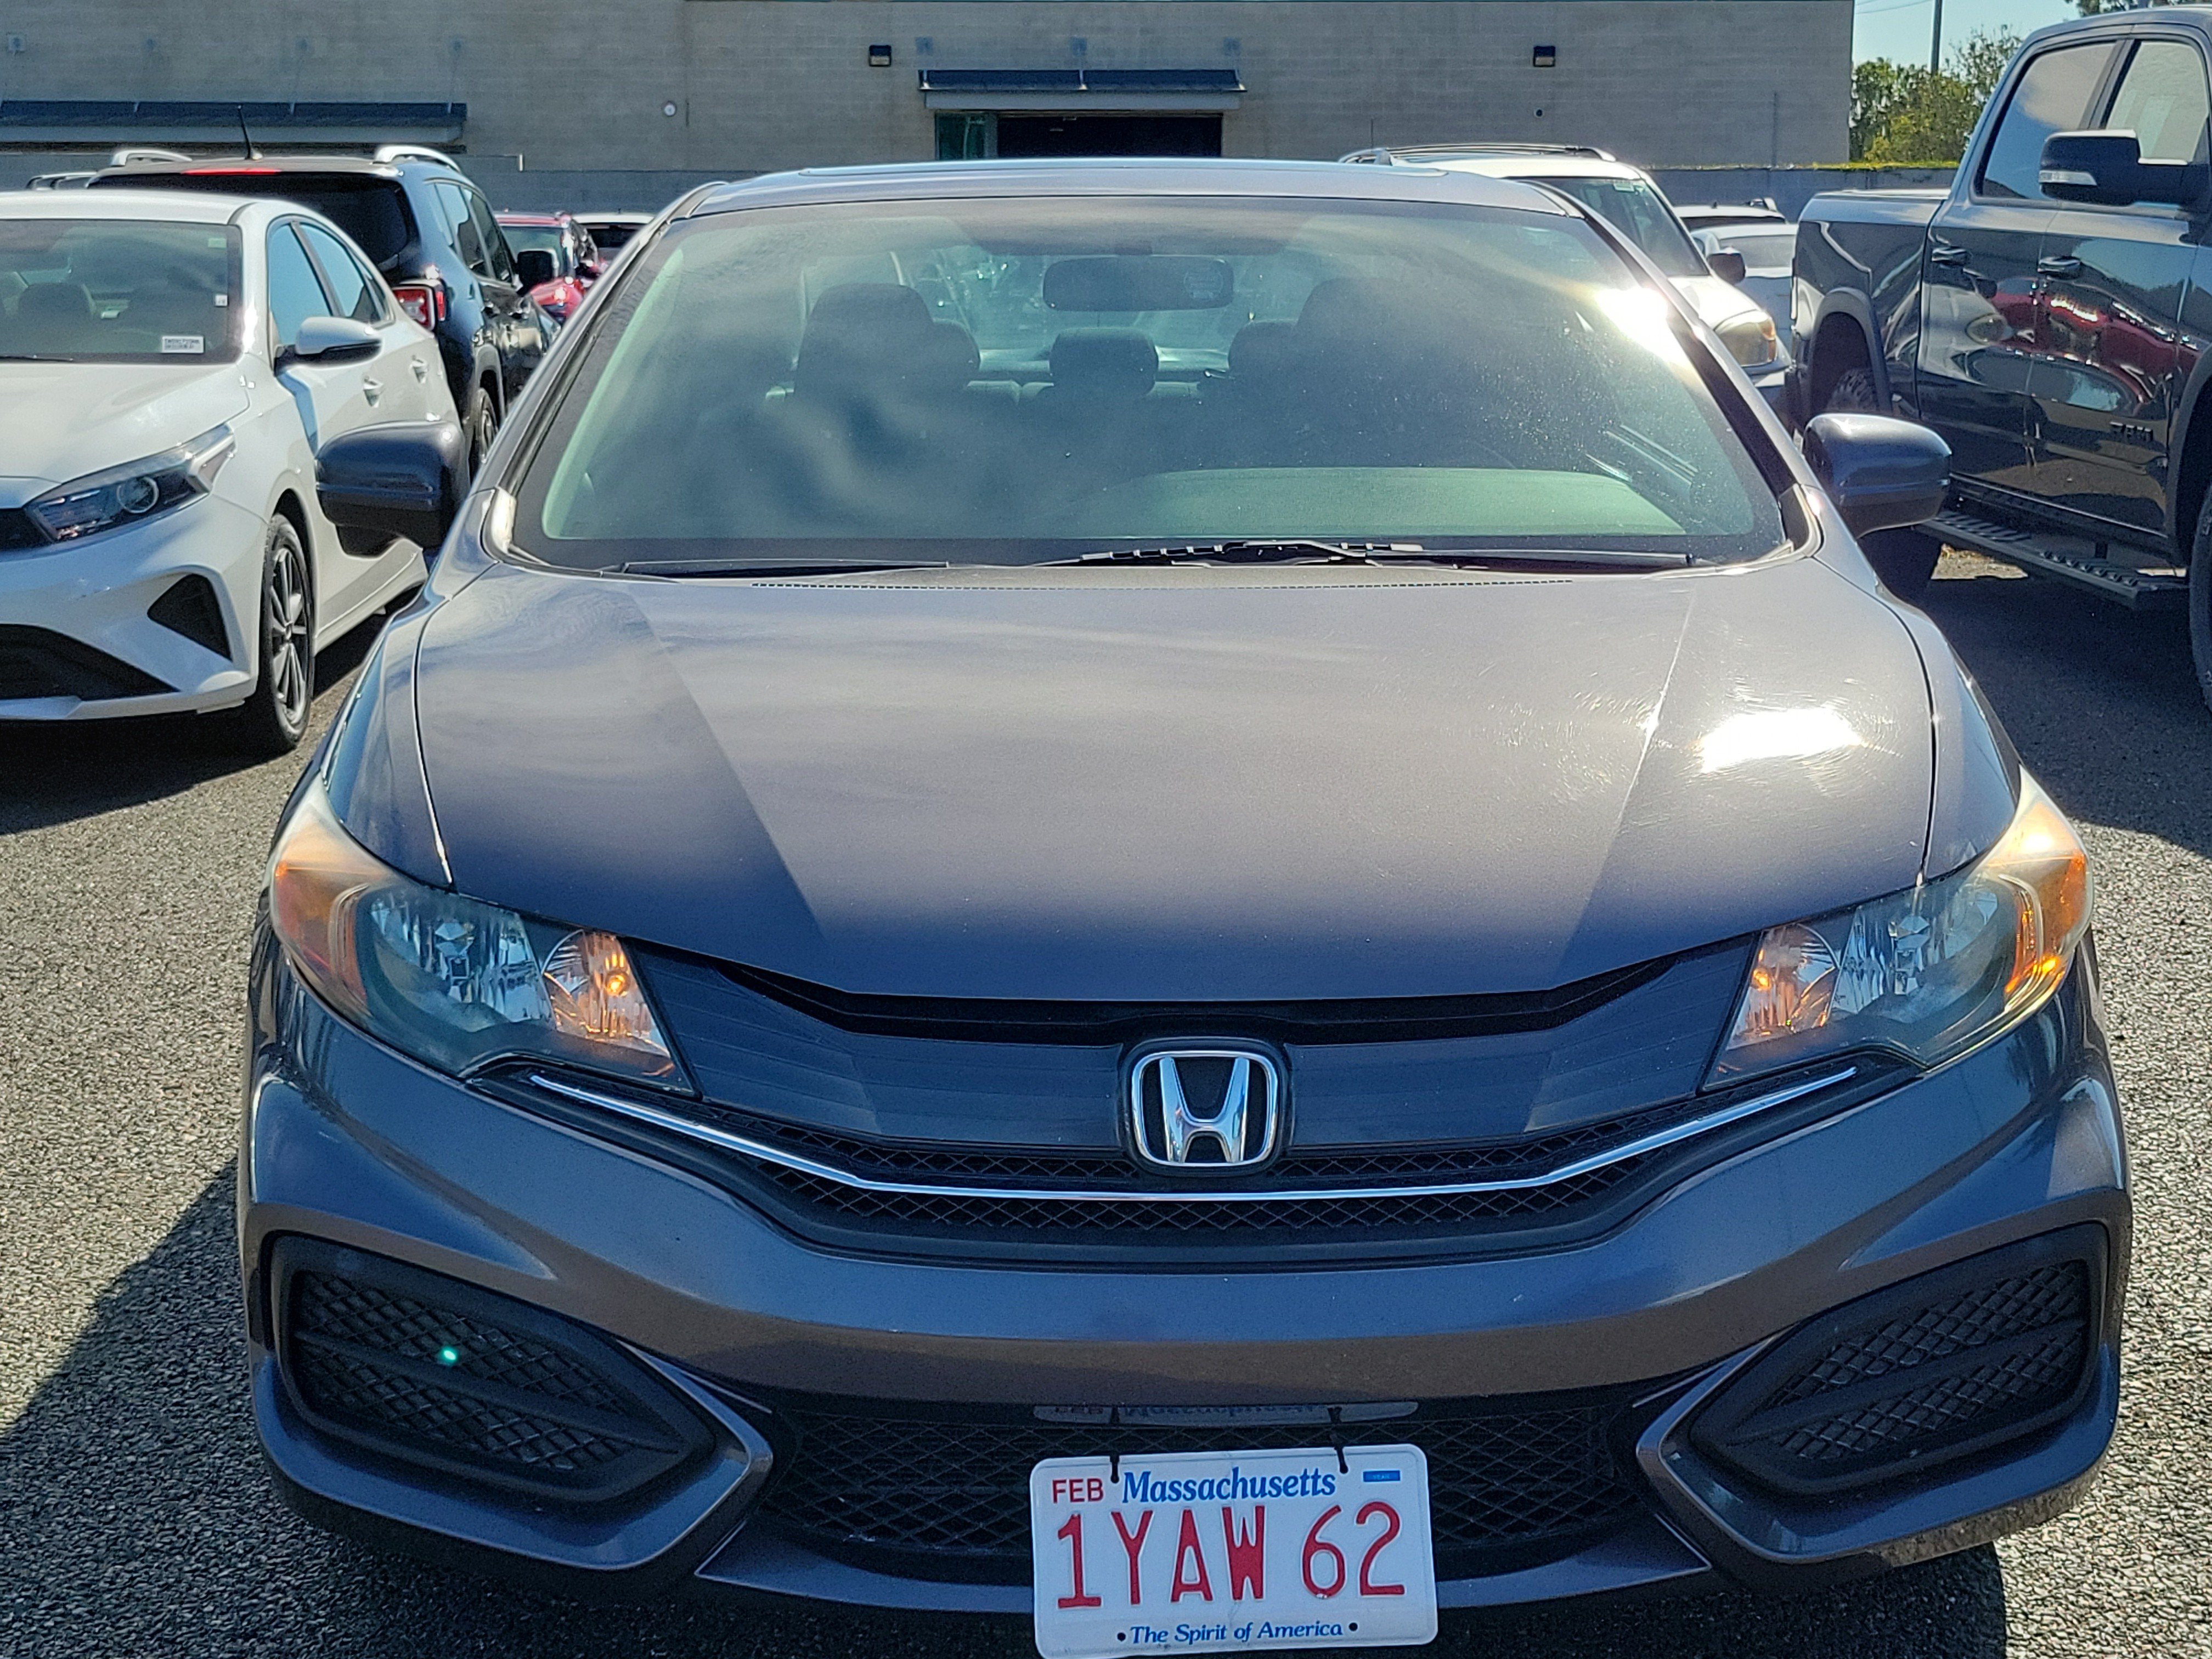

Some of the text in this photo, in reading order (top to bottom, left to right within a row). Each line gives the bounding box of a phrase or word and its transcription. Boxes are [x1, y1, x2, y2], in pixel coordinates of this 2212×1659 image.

[1052, 1467, 1336, 1503] FEB Massachusetts
[1057, 1501, 1405, 1609] 1YAW 62
[1130, 1620, 1342, 1644] The Spirit of America
